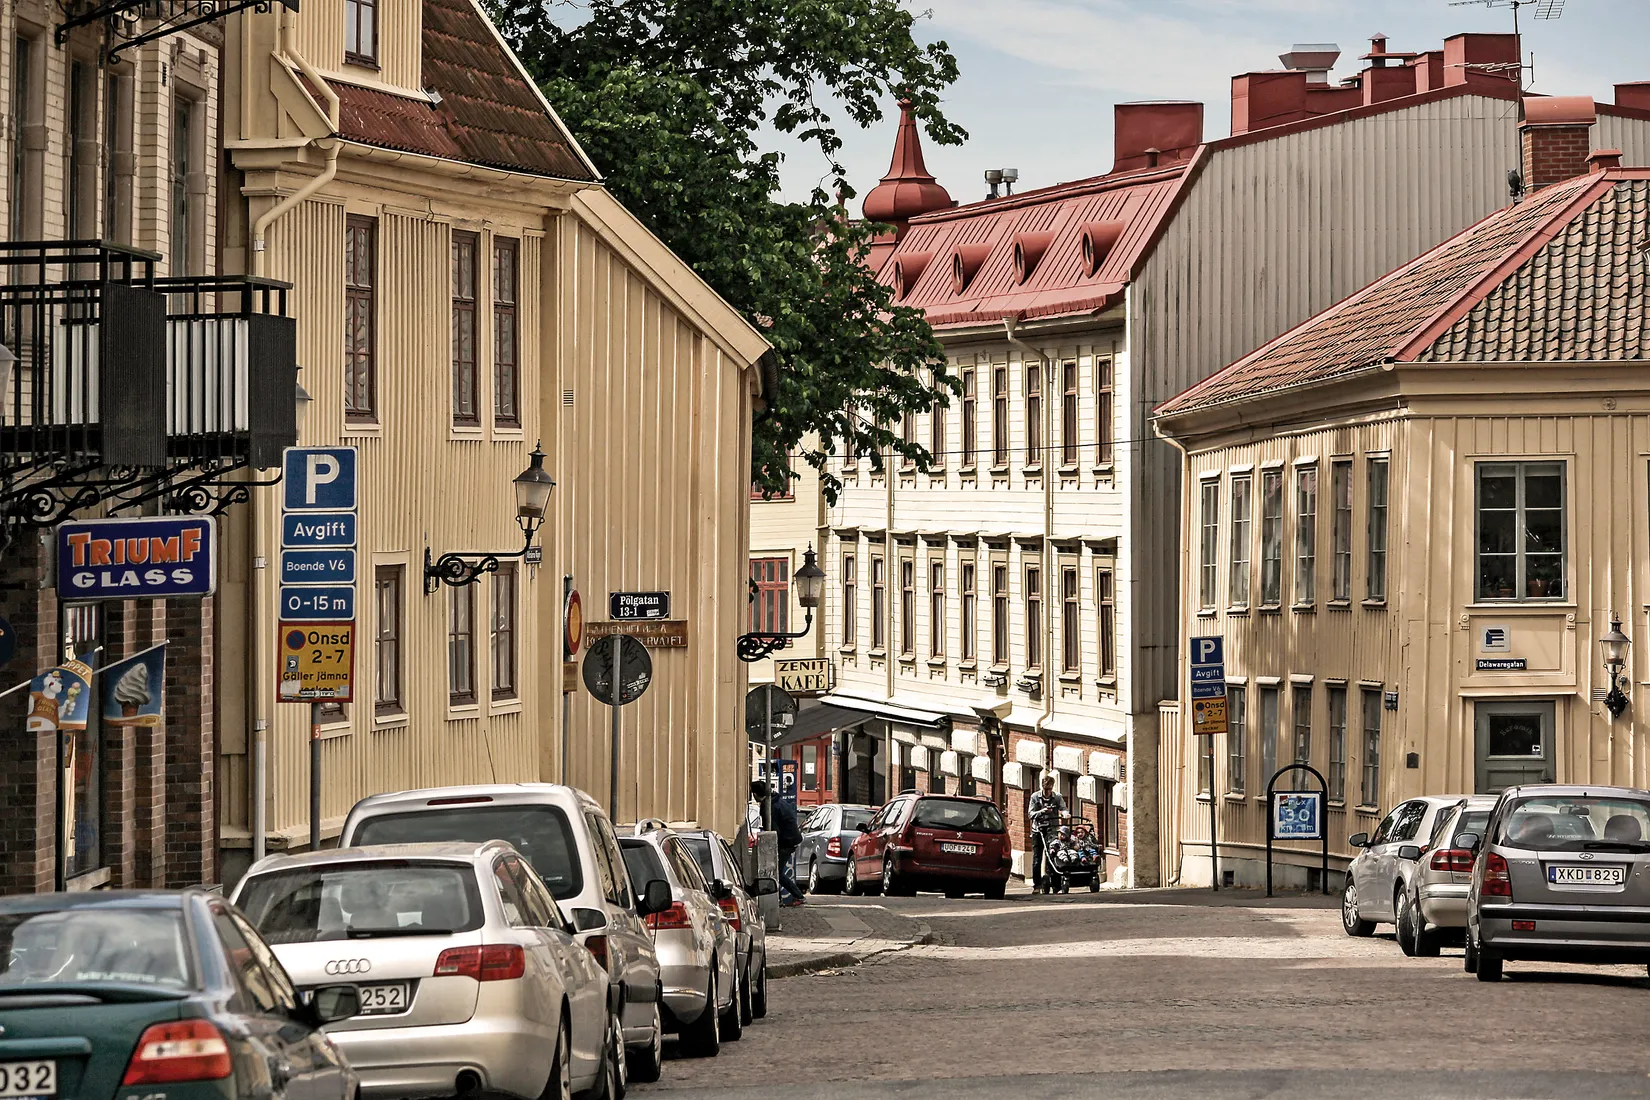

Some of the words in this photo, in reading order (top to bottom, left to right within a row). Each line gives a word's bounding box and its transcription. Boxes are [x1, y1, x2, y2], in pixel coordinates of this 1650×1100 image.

[306, 454, 340, 504] P
[293, 522, 346, 540] Avgift
[67, 527, 202, 567] TRIUMF
[286, 561, 325, 571] Boende
[328, 559, 346, 571] V6
[72, 568, 194, 588] GLASS
[332, 598, 346, 610] m
[620, 595, 659, 607] Pölgatan
[620, 606, 638, 617] 13-1
[307, 631, 350, 645] Onsd
[311, 649, 345, 664] 2-7
[1200, 639, 1216, 663] P
[778, 660, 827, 672] ZENIT
[1478, 660, 1524, 669] Delawaregatan
[282, 671, 314, 680] Gäller
[316, 671, 348, 682] jämna
[781, 669, 826, 690] KAFÉ
[1195, 669, 1220, 679] Avgift
[1204, 701, 1225, 709] Onsd
[1207, 709, 1223, 717] 2-7
[1285, 808, 1310, 822] 30
[1558, 869, 1584, 880] XKD
[1594, 870, 1620, 881] 829
[362, 988, 400, 1006] 252
